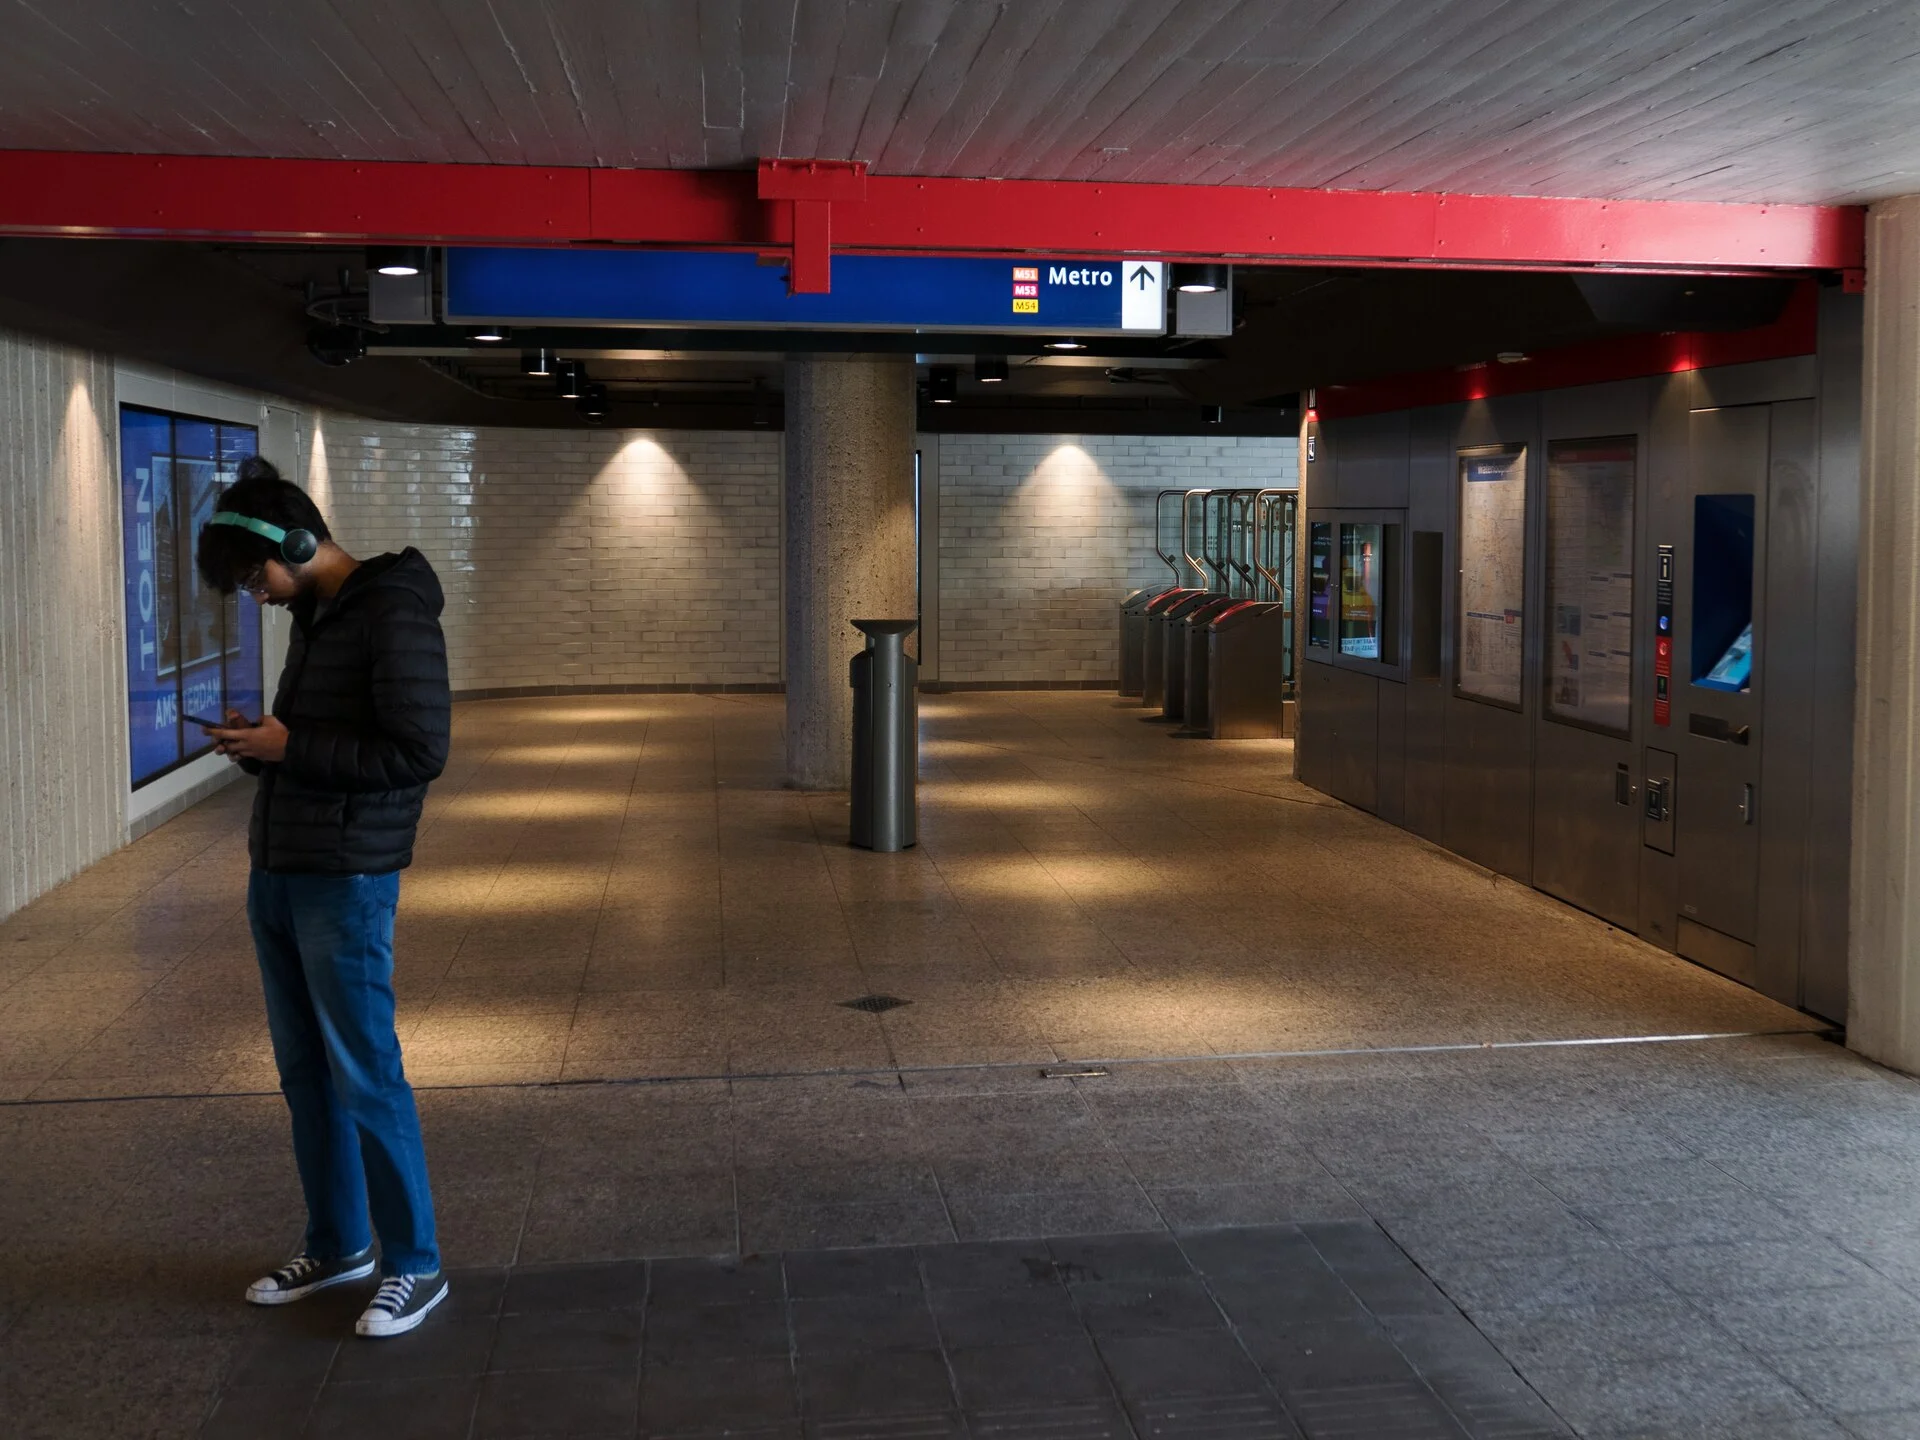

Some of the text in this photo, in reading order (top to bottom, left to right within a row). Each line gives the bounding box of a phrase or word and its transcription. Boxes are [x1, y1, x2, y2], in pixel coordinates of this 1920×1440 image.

[1014, 269, 1037, 280] M51
[1048, 266, 1113, 286] Metro
[1014, 285, 1037, 295] M53
[1015, 301, 1036, 310] M54
[135, 467, 155, 672] TOEN
